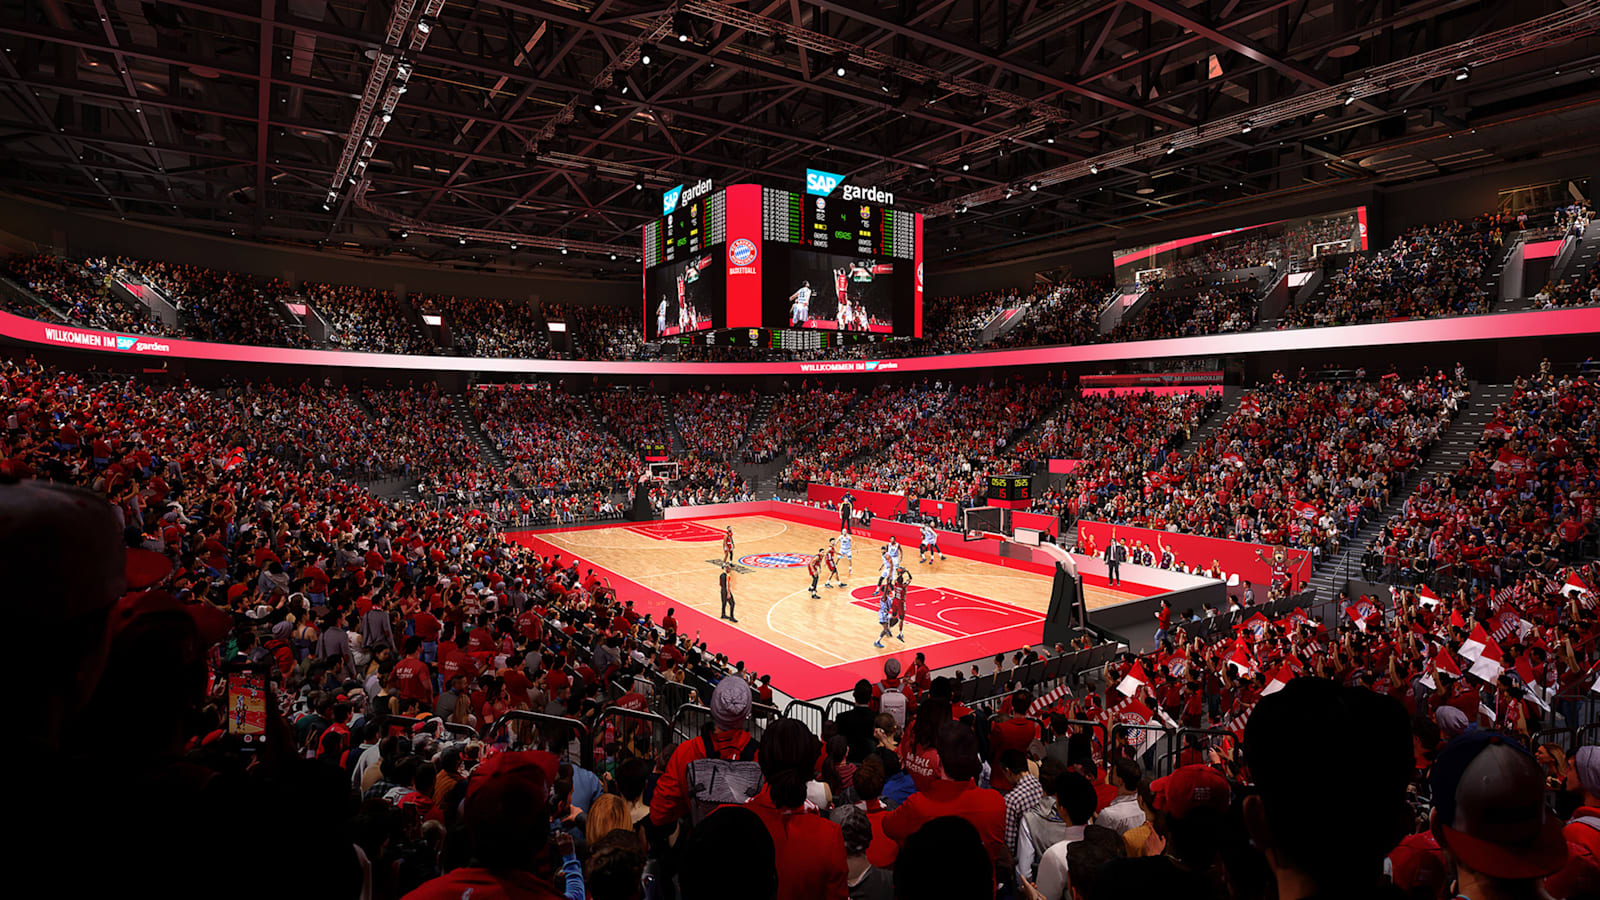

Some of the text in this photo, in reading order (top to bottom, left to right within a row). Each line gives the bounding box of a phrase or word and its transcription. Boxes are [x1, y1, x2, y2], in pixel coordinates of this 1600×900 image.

[664, 178, 712, 211] SAP garden
[807, 173, 894, 205] SAP garden
[45, 327, 170, 352] WILLKOMMEN IM SAP garden
[800, 363, 854, 372] WILLKOMMEN
